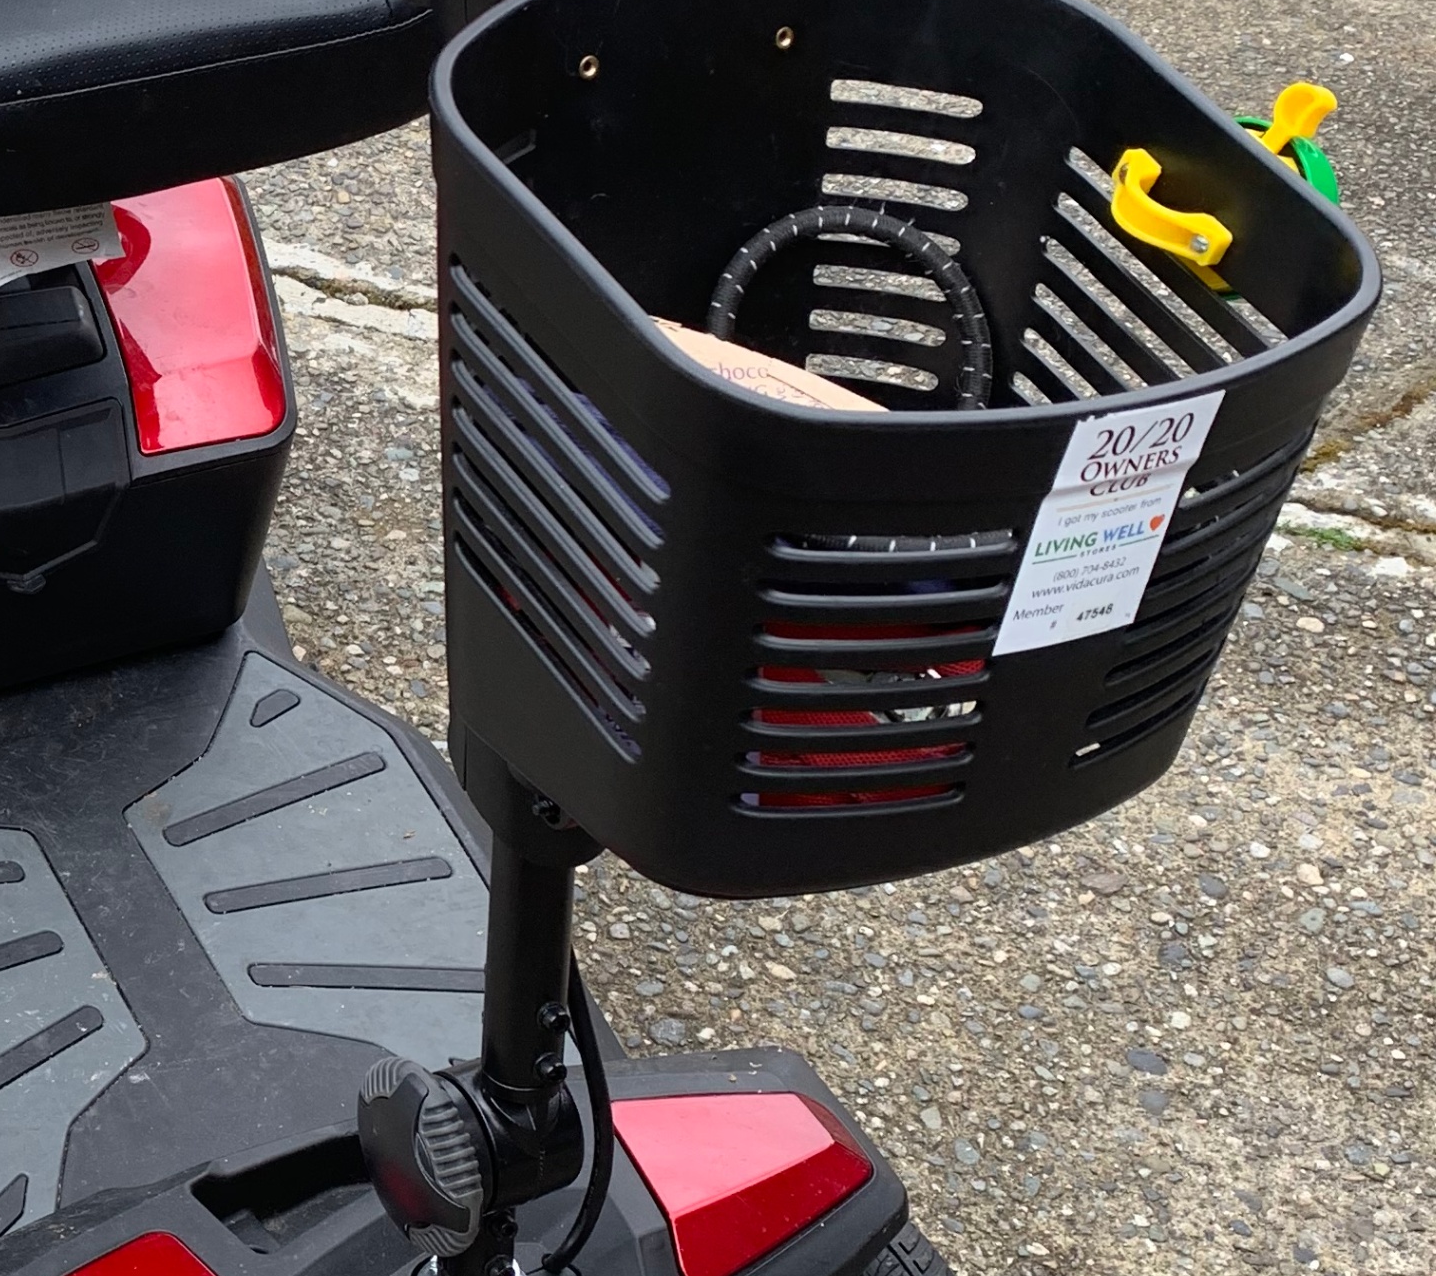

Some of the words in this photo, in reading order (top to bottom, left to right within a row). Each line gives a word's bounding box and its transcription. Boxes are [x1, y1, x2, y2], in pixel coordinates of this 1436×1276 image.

[1087, 412, 1194, 461] 20/20
[1080, 445, 1182, 482] OWNERS
[1090, 473, 1151, 496] CLUB
[1034, 531, 1099, 557] LIVING
[1103, 521, 1145, 542] WELL
[1013, 604, 1065, 621] Member
